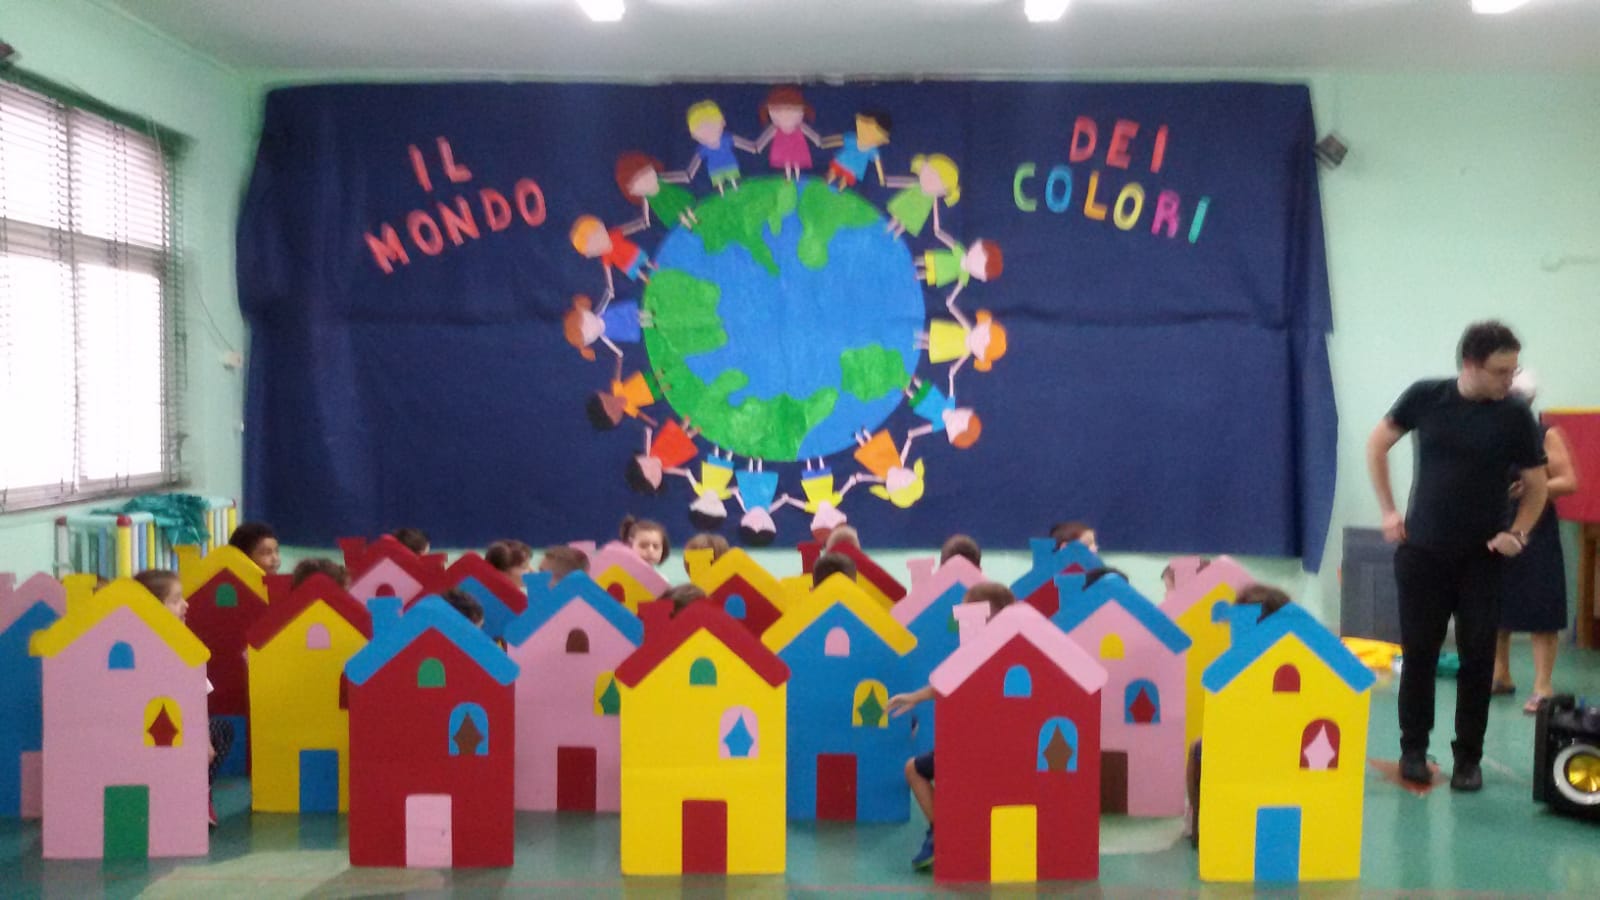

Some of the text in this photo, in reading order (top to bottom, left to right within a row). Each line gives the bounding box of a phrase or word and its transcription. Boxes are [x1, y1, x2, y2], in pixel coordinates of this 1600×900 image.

[408, 136, 473, 192] IL
[1069, 115, 1169, 174] DEI
[364, 177, 548, 275] MONDO
[1013, 161, 1211, 244] COLORI
